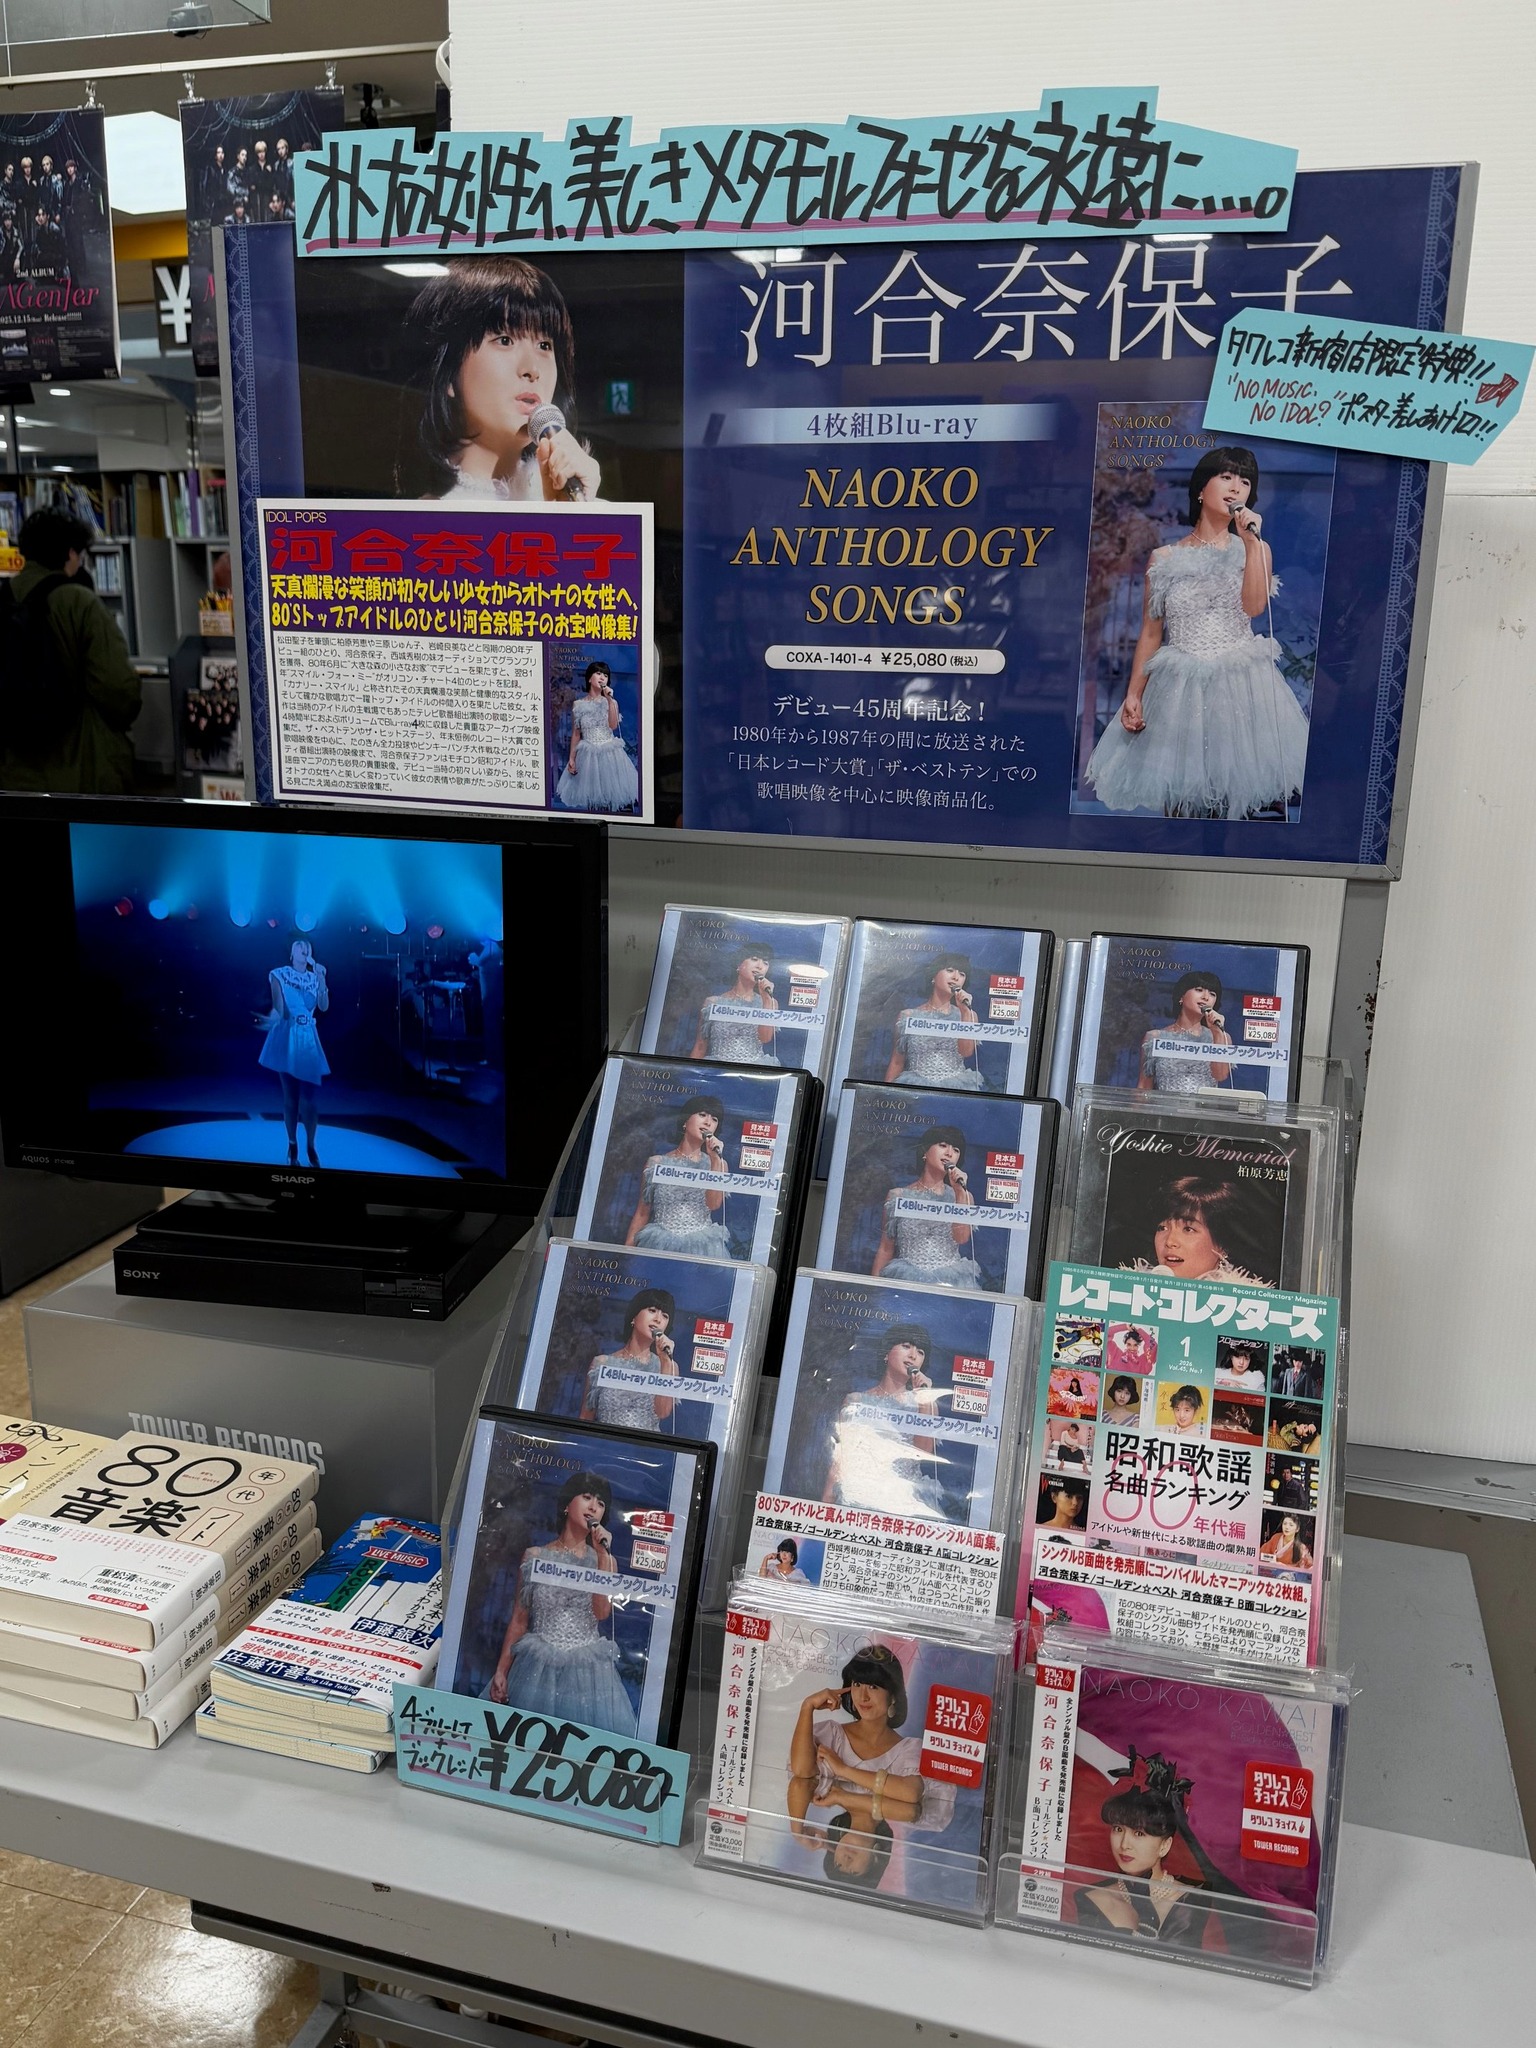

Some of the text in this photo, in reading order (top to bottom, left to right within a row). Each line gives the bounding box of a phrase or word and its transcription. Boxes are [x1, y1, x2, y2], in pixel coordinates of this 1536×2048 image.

[739, 234, 1355, 369] 河合奈保子
[1110, 415, 1172, 430] NAOKO
[1249, 400, 1277, 425] NO
[806, 411, 980, 441] 4枚組Blu-ray
[1108, 434, 1220, 449] ANTHOLOGY
[1107, 453, 1165, 468] SONGS
[799, 466, 979, 508] NAOKO
[265, 511, 327, 524] IDOL POPS
[271, 527, 637, 580] 河合奈保子
[730, 526, 1055, 568] ANTHOLOGY
[805, 584, 965, 625] SONGS
[786, 651, 873, 665] COXA-1401-4
[733, 725, 1026, 753] 1980年から1987年の間に放送された
[757, 781, 996, 812] 歌唱映像を中心に映像商品化。
[792, 996, 817, 1006] ¥25,080
[993, 1009, 1018, 1018] ¥25,080
[1248, 1030, 1276, 1040] ¥25,080
[1097, 1122, 1296, 1166] Yoshie Memorial
[22, 1155, 50, 1163] AQUOS
[743, 1158, 770, 1169] ¥25,080
[271, 1174, 315, 1186] SHARP
[1236, 1165, 1288, 1182] 柏原芳恵
[990, 1190, 1018, 1200] ¥25,080
[123, 1269, 161, 1281] SONY
[1232, 1287, 1256, 1296] Record
[1295, 1295, 1328, 1306] Magazine
[1059, 1273, 1327, 1343] レコード・コレクターズ
[1180, 1336, 1191, 1357] 1
[695, 1360, 724, 1372] ¥25,080
[963, 1359, 986, 1370] 見本品
[1178, 1359, 1193, 1367] 2026
[956, 1400, 987, 1413] ¥25,080
[215, 1425, 326, 1475] RECORDS
[1104, 1431, 1251, 1486] 昭和歌謡
[1103, 1470, 1250, 1511] 名曲ランキング
[50, 1487, 200, 1538] 音楽
[1193, 1516, 1247, 1540] 年代編
[371, 1548, 424, 1566] LIVE MUSIC
[885, 1537, 933, 1557] 河合奈保子
[635, 1556, 666, 1570] ¥25,080
[1181, 1588, 1234, 1608] 河合奈保子
[354, 1617, 435, 1649] 伊藤銀次
[769, 1616, 875, 1659] NAOKO
[223, 1650, 308, 1681] 佐藤竹善
[302, 1675, 359, 1694] Sing Like Talking
[724, 1643, 746, 1739] 河合奈保子
[936, 1694, 970, 1717] タワレコ
[1082, 1675, 1317, 1730] NAOKO KAWAI
[935, 1711, 968, 1733] チョイス
[929, 1735, 973, 1754] タワレコ チョイス
[1036, 1694, 1059, 1793] 河合奈保子
[931, 1760, 973, 1778] TOWER RECORDS
[1253, 1771, 1291, 1792] タワレコ
[1253, 1788, 1290, 1808] チョイス
[1250, 1814, 1298, 1832] タワレコ チョイス
[1253, 1839, 1299, 1855] TOWER RECORDS
